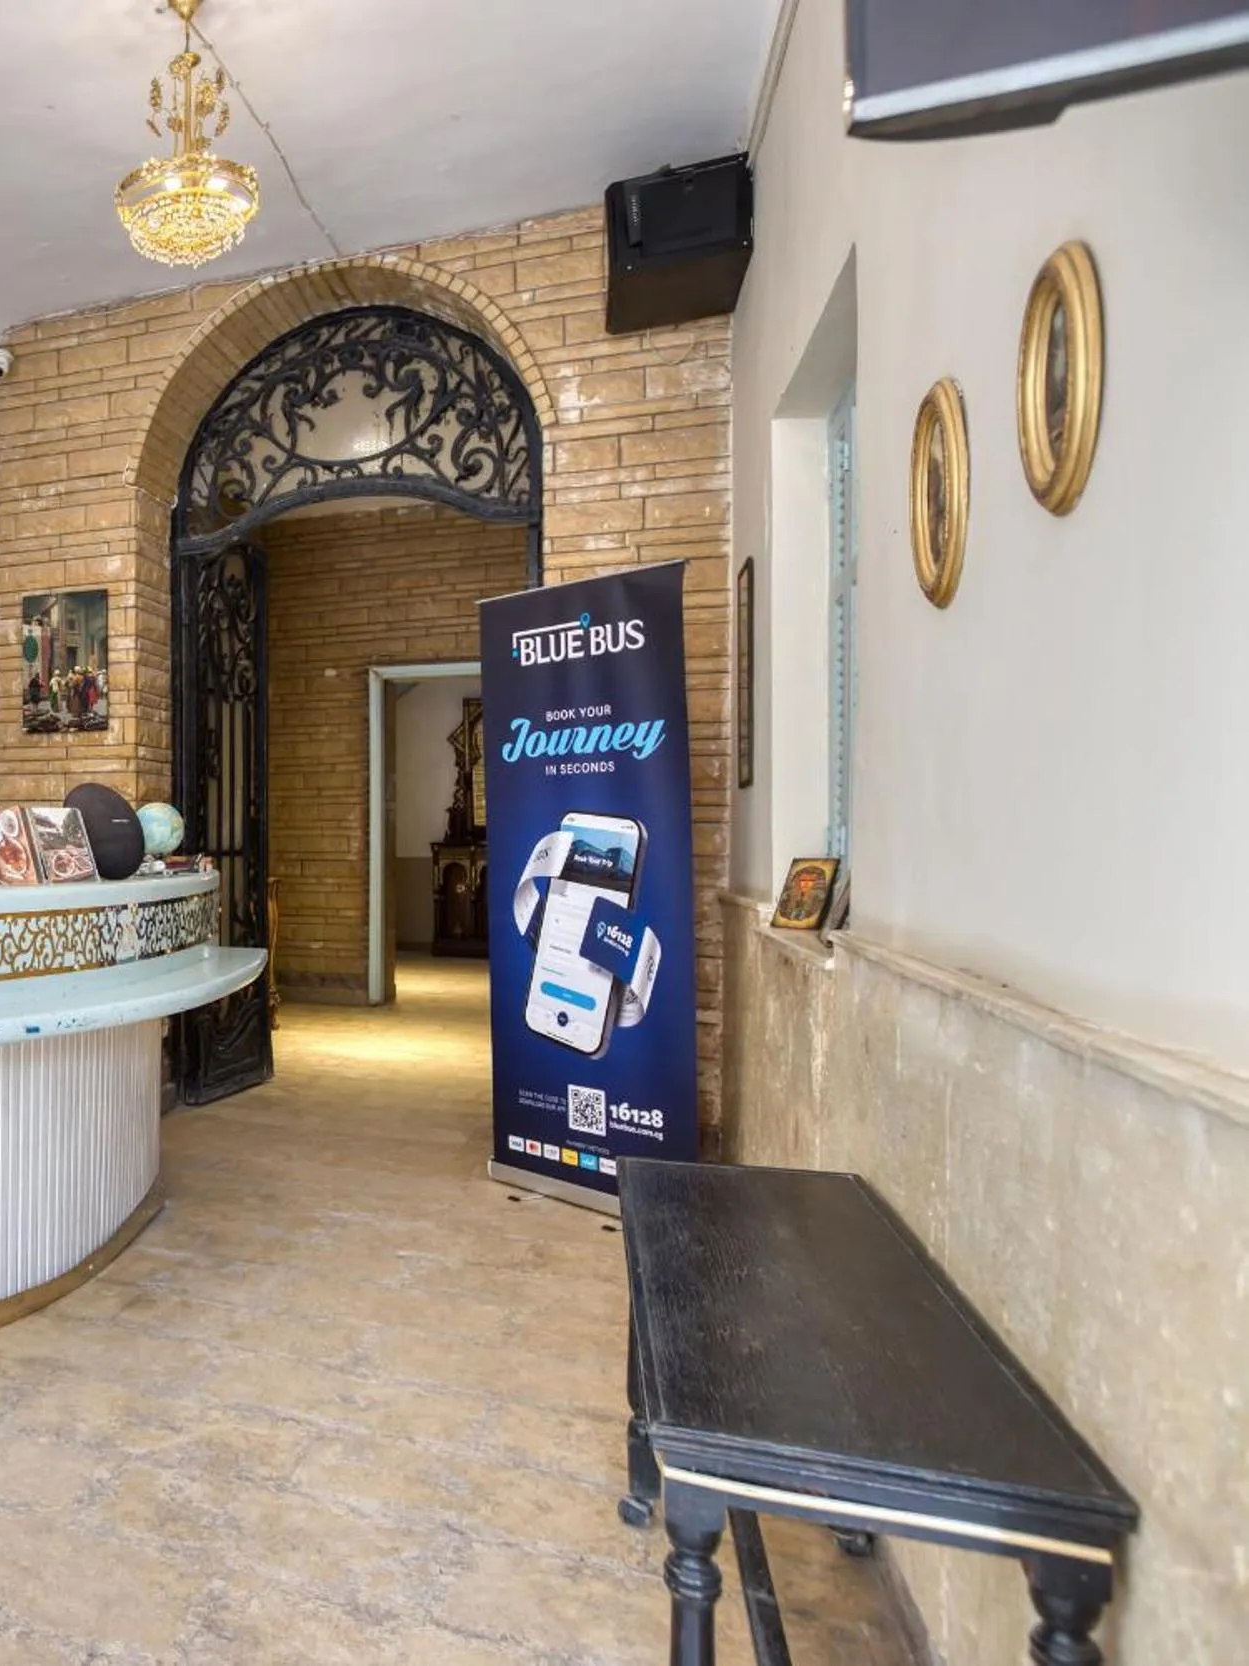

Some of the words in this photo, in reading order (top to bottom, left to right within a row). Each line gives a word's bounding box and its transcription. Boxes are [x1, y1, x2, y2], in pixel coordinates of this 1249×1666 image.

[519, 630, 584, 667] BLUE
[590, 619, 645, 656] BUS
[546, 708, 576, 723] BOOK
[579, 704, 612, 718] YOUR
[502, 717, 666, 762] Journey
[545, 765, 557, 776] IN
[560, 761, 615, 774] SECONDS
[607, 926, 633, 948] 16128
[609, 1102, 664, 1128] 16128
